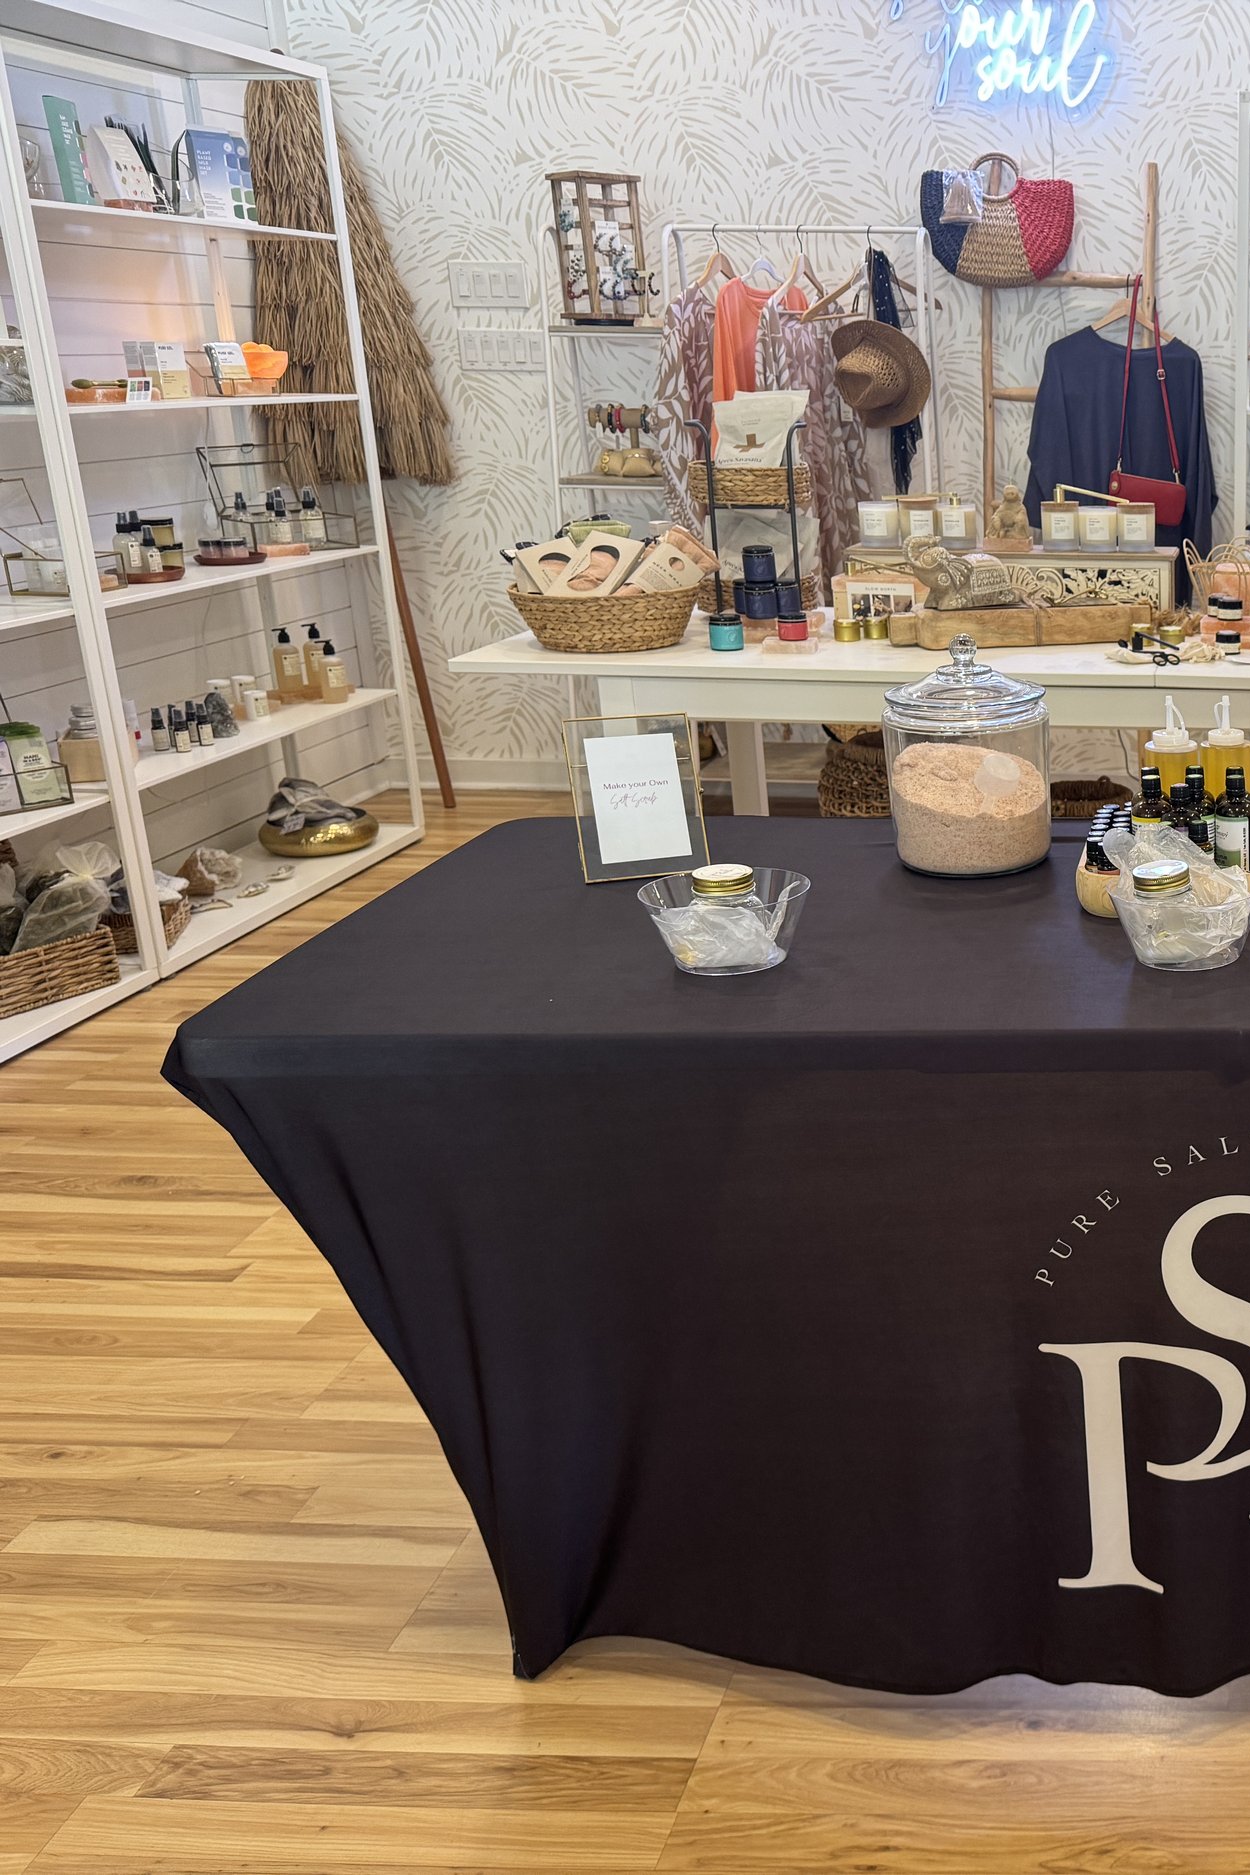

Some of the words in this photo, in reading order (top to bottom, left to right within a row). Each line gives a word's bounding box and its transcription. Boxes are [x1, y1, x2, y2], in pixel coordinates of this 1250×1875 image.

[925, 0, 1052, 107] your
[977, 0, 1108, 108] soul
[628, 781, 647, 790] your
[648, 779, 669, 787] Own
[1034, 1189, 1121, 1287] PURE
